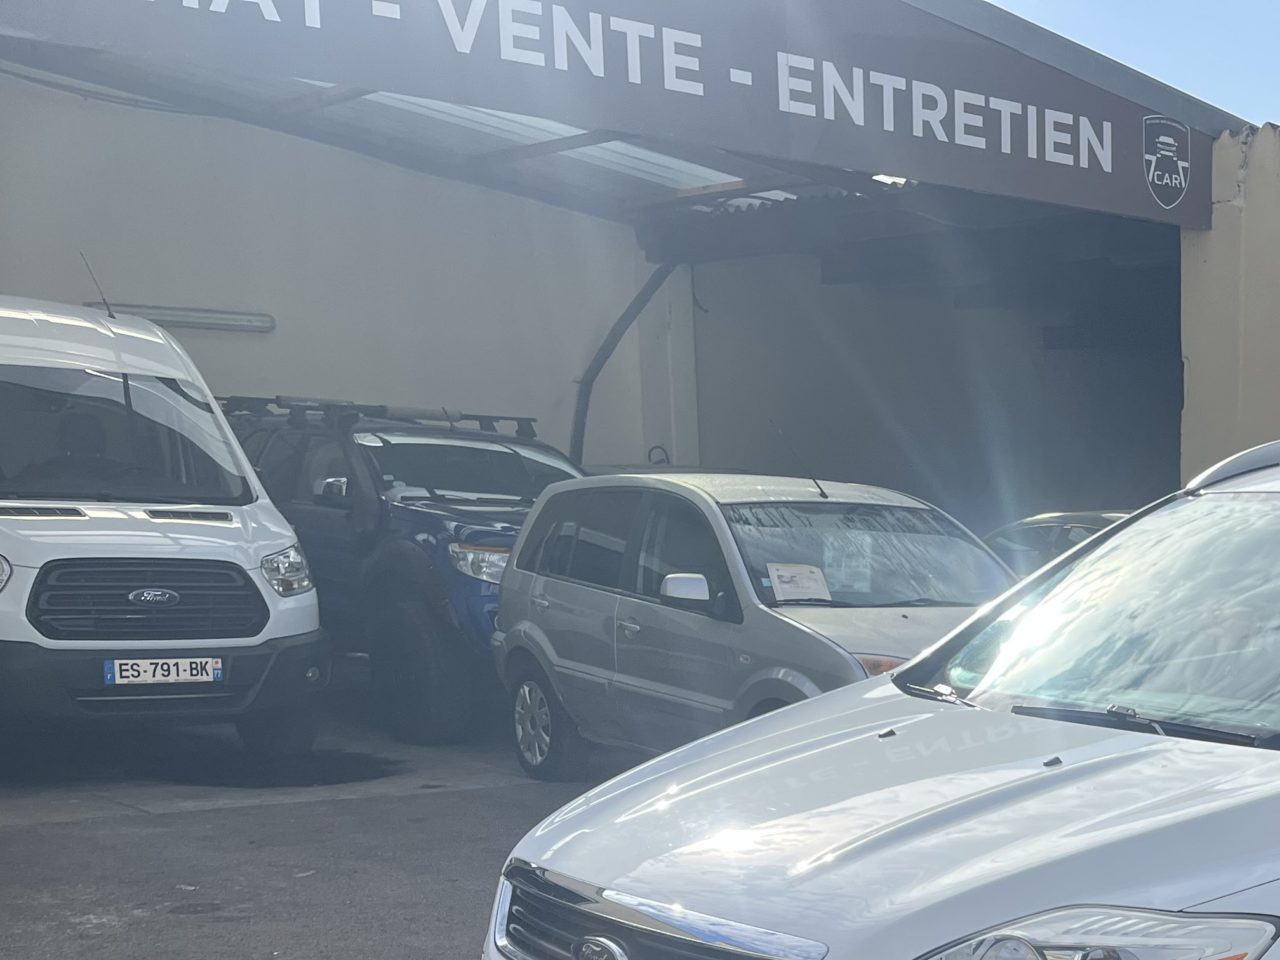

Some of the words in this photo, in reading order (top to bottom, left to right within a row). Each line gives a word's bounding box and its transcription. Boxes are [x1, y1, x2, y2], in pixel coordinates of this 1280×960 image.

[437, 0, 704, 96] VENTE
[776, 51, 1112, 173] ENTRETIEN
[118, 661, 210, 679] ES-791-BK
